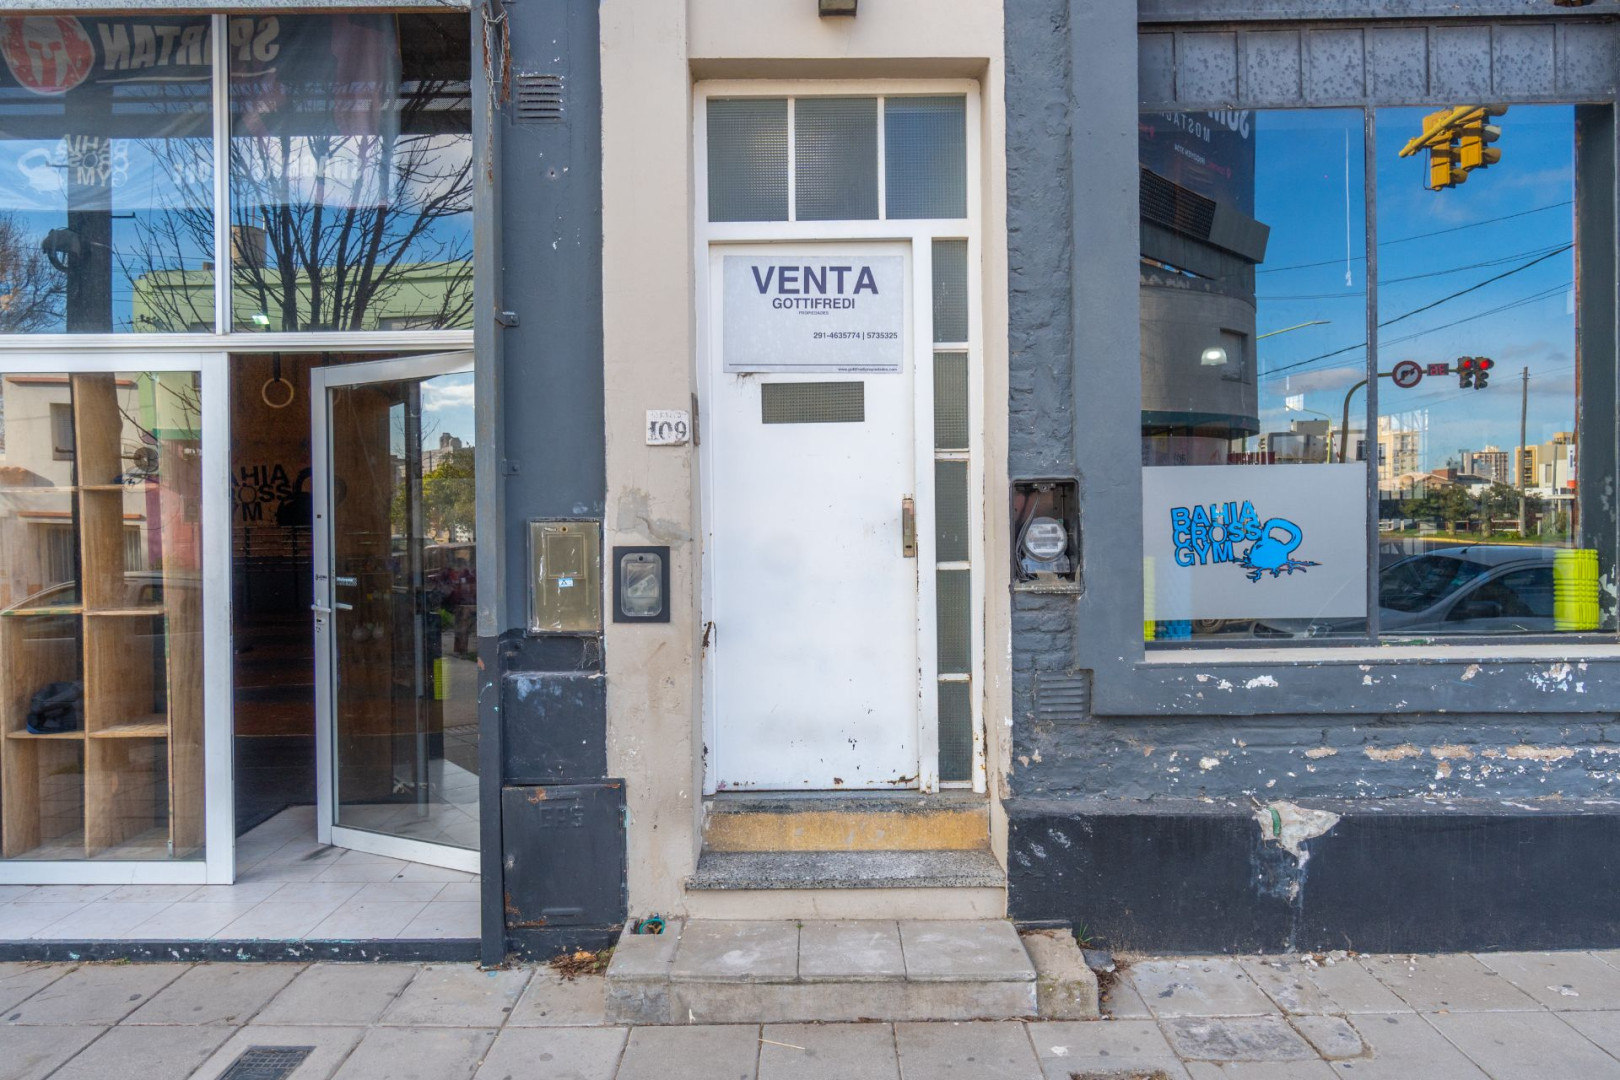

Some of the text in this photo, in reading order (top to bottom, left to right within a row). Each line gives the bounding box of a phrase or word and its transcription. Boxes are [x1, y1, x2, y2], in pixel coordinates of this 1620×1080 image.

[751, 265, 879, 295] VENTA
[772, 297, 855, 309] GOTTIFREDI
[813, 331, 860, 339] 291-4635774
[866, 331, 898, 339] 5735325
[647, 420, 687, 440] 109
[1170, 500, 1263, 533] BAHIA
[1173, 521, 1264, 549] CROSS
[1175, 541, 1236, 568] GYM
